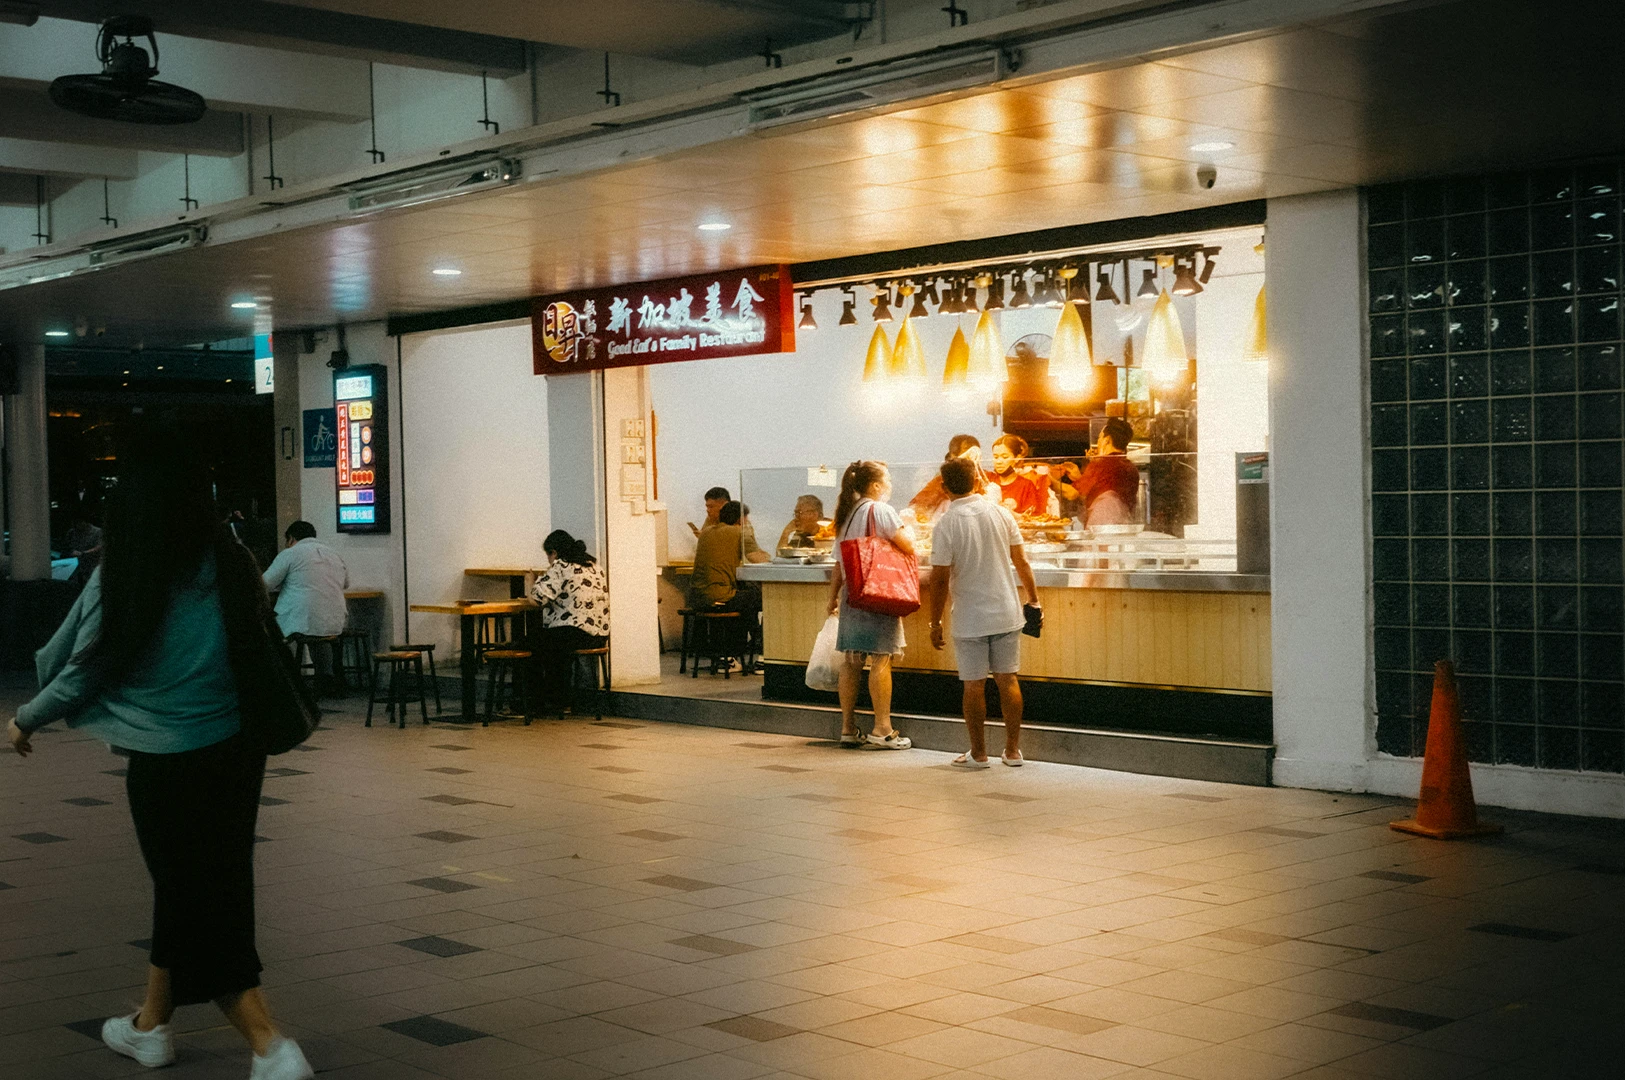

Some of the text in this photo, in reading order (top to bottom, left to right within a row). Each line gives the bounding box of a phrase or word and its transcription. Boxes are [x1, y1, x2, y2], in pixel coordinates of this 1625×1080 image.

[605, 277, 765, 338] 新加坡美食
[607, 340, 632, 359] Good
[659, 335, 697, 352] Family
[699, 330, 765, 348] Restaurant
